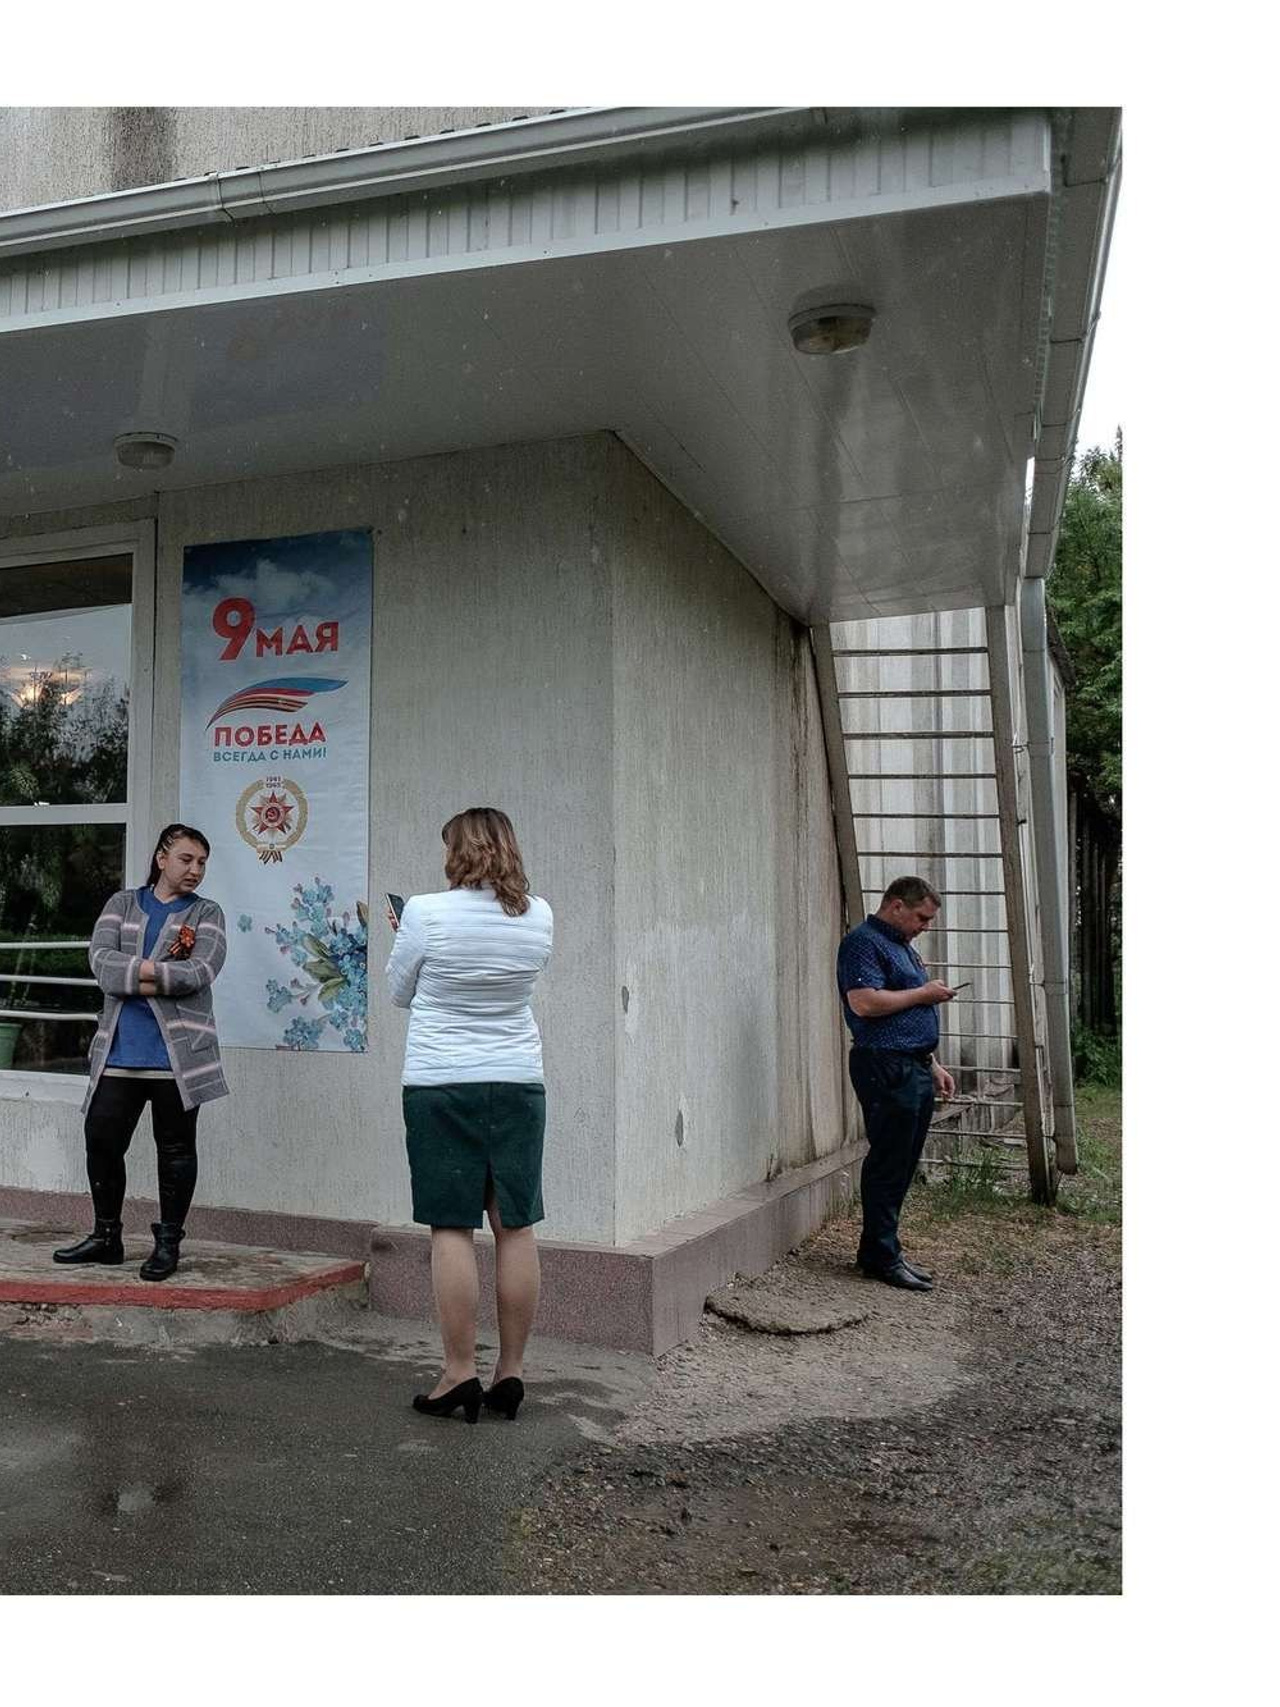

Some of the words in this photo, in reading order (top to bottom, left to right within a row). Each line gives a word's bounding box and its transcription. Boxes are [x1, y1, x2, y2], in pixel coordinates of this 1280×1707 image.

[213, 598, 255, 661] 9
[256, 621, 339, 657] МАЯ
[215, 722, 326, 747] ПОБЕДА
[213, 751, 267, 763] ВСЕГДА
[270, 749, 279, 761] С
[283, 747, 327, 760] НАМИ!
